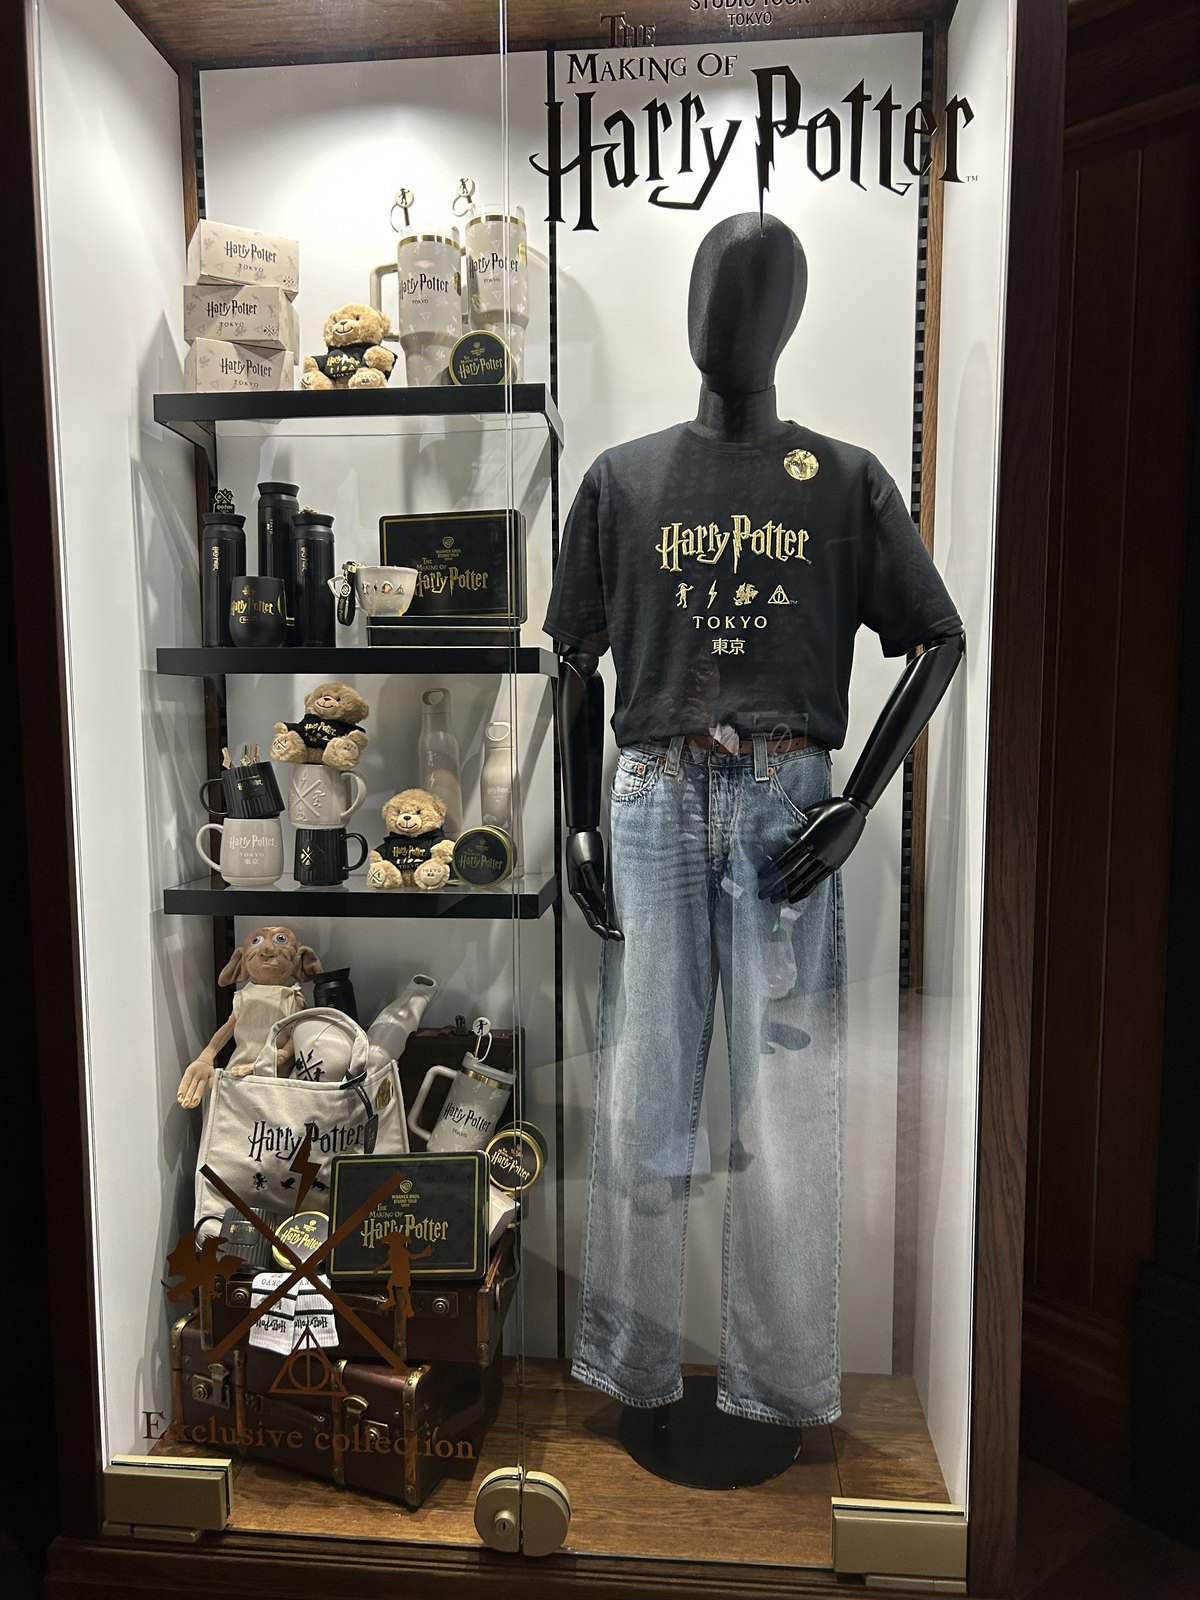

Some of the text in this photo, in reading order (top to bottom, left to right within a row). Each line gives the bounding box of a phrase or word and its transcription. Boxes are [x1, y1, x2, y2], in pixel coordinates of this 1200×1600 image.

[728, 12, 772, 26] TOKYO
[528, 65, 975, 238] Harry Potter
[224, 241, 277, 263] Harry Potter
[238, 263, 264, 273] TOKYO
[419, 273, 449, 295] Potter
[206, 300, 258, 318] Harry Potter
[220, 358, 272, 377] Harry Potter
[458, 362, 480, 379] Harry
[479, 358, 503, 376] Potter
[234, 380, 259, 388] TOKYO
[655, 514, 810, 574] Harry Potter
[448, 566, 489, 597] Potter
[692, 615, 768, 629] TOKYO
[711, 638, 746, 655] 東京
[228, 834, 275, 850] Harry Potter
[460, 854, 503, 870] Harry Potter
[443, 1102, 492, 1132] Harry Potter
[248, 1121, 303, 1162] Harry
[490, 1151, 512, 1169] Harry
[280, 1230, 303, 1245] Harry
[405, 1214, 449, 1248] Potter
[268, 1319, 286, 1333] Harry
[142, 1410, 476, 1460] Exclusive collection
